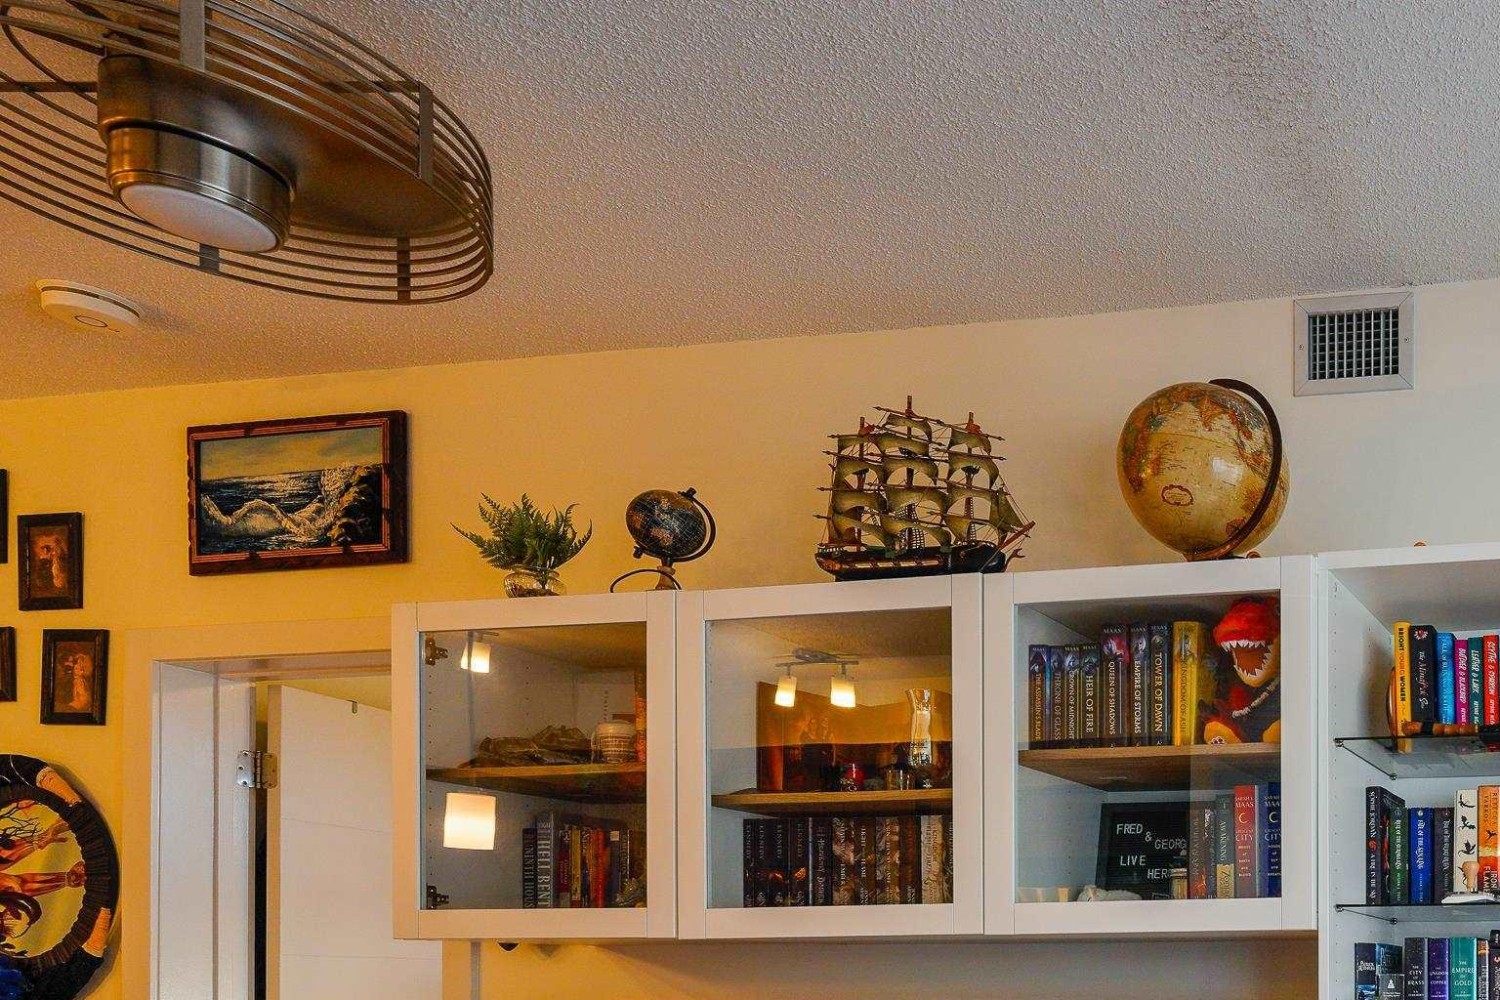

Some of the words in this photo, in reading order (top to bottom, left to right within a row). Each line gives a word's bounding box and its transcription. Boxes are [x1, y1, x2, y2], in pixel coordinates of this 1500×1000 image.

[1154, 652, 1162, 687] TOWER
[1154, 689, 1162, 700] OF
[1086, 698, 1093, 711] OF
[1154, 703, 1162, 732] DAWN
[1116, 823, 1143, 835] FRED
[1145, 831, 1152, 842] &
[1154, 839, 1187, 850] GEORG
[1120, 855, 1146, 866] LIVE
